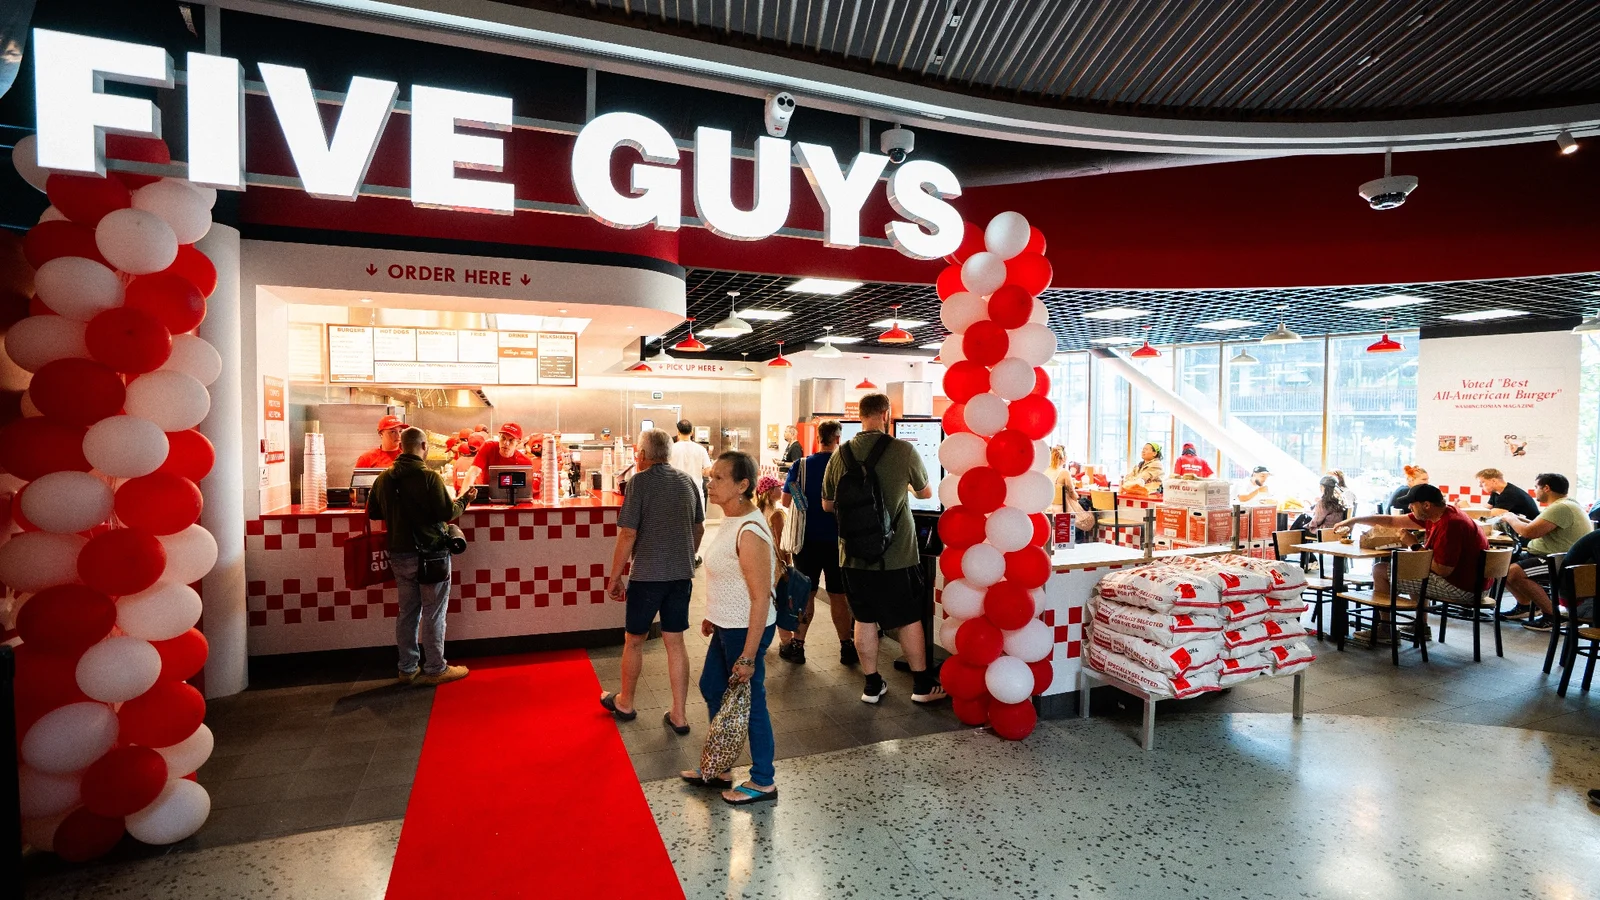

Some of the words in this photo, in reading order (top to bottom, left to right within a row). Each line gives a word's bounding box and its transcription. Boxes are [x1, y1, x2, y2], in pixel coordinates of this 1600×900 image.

[33, 28, 515, 214] FIVE
[571, 111, 965, 261] GUYS
[387, 263, 455, 283] ORDER
[465, 268, 511, 286] HERE
[666, 363, 683, 371] PICK
[698, 364, 716, 372] HERE
[1461, 378, 1494, 389] Voted
[1498, 378, 1529, 388] "Best
[1433, 390, 1510, 401] All-American
[1515, 389, 1563, 402] Burger"
[371, 549, 391, 561] FIV
[370, 560, 392, 572] GU
[1137, 617, 1164, 628] SELECTED
[1134, 651, 1159, 670] SELECTED
[1107, 661, 1132, 675] SPECIALLY
[1131, 672, 1159, 688] SELECTED
